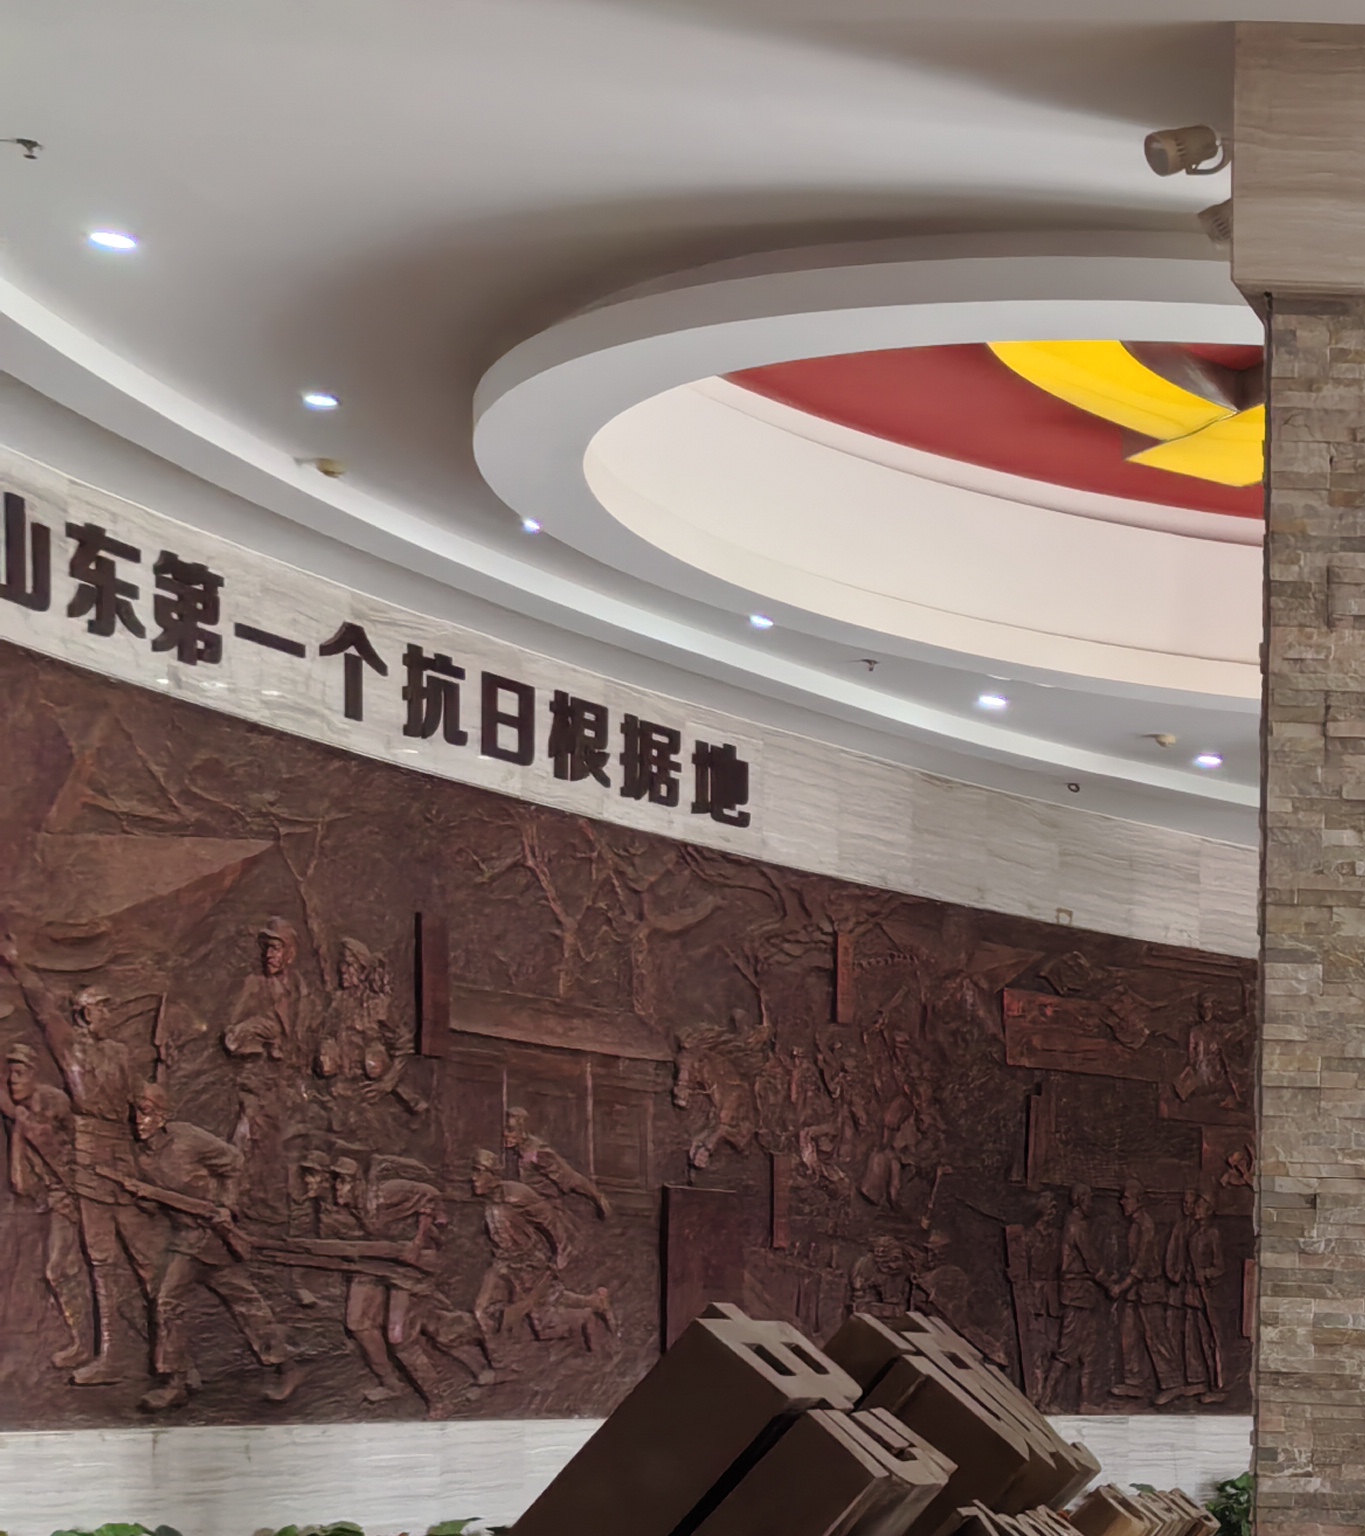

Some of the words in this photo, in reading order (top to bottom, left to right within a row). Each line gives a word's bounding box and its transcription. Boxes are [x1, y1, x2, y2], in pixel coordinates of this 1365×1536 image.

[0, 490, 750, 828] 山东第一个抗日根据地
